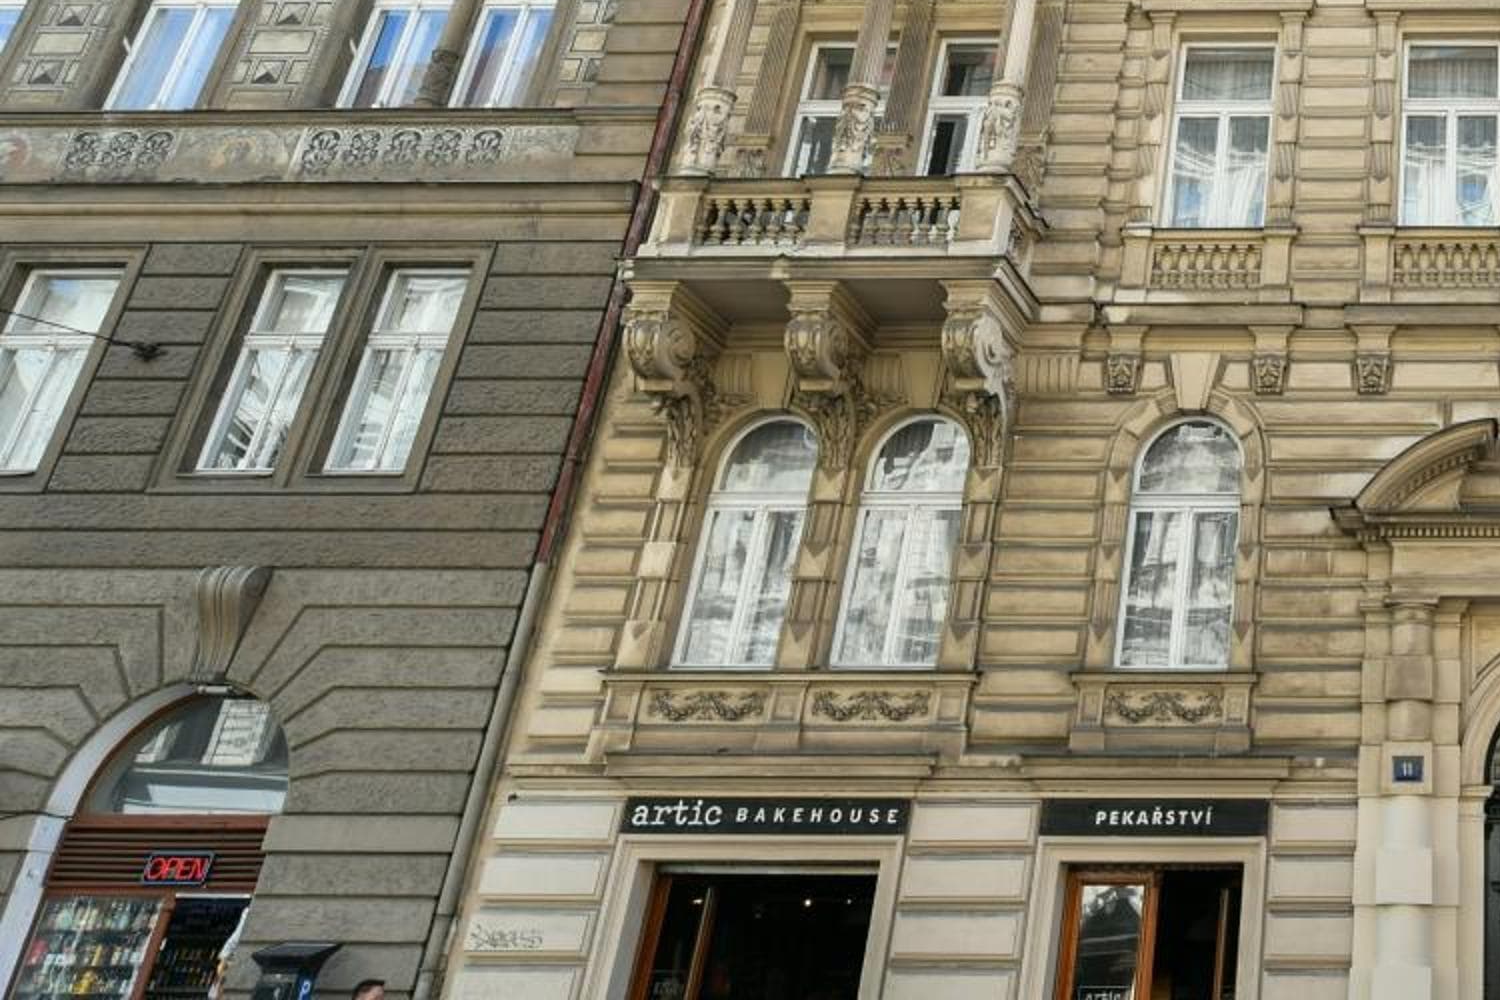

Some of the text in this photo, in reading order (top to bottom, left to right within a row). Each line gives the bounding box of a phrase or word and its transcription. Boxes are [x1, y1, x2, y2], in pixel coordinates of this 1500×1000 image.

[631, 799, 899, 826] artic BAKEHOUSE
[1095, 806, 1214, 825] PEKAŘSTVÍ
[145, 857, 209, 880] OPEN
